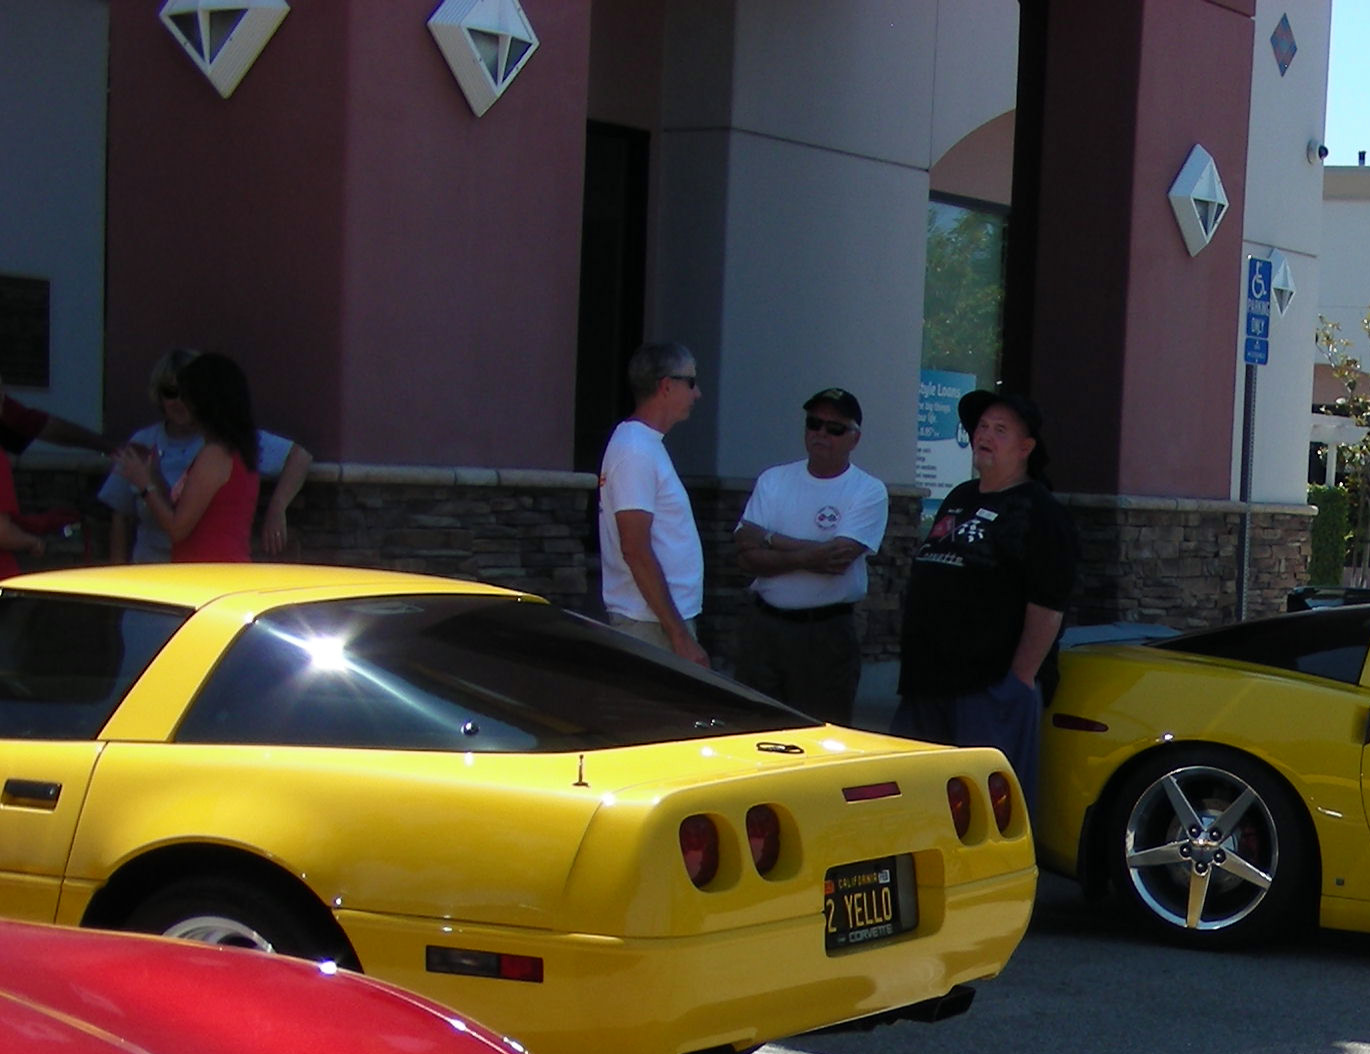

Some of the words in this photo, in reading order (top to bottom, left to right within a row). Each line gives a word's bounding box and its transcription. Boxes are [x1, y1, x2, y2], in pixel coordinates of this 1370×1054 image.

[1247, 299, 1270, 316] PARKING
[1250, 318, 1265, 336] ONLY
[838, 872, 878, 889] CALIFORNIA
[825, 898, 838, 933] 2
[843, 887, 893, 929] YELLO
[848, 923, 894, 943] CORVETTE
